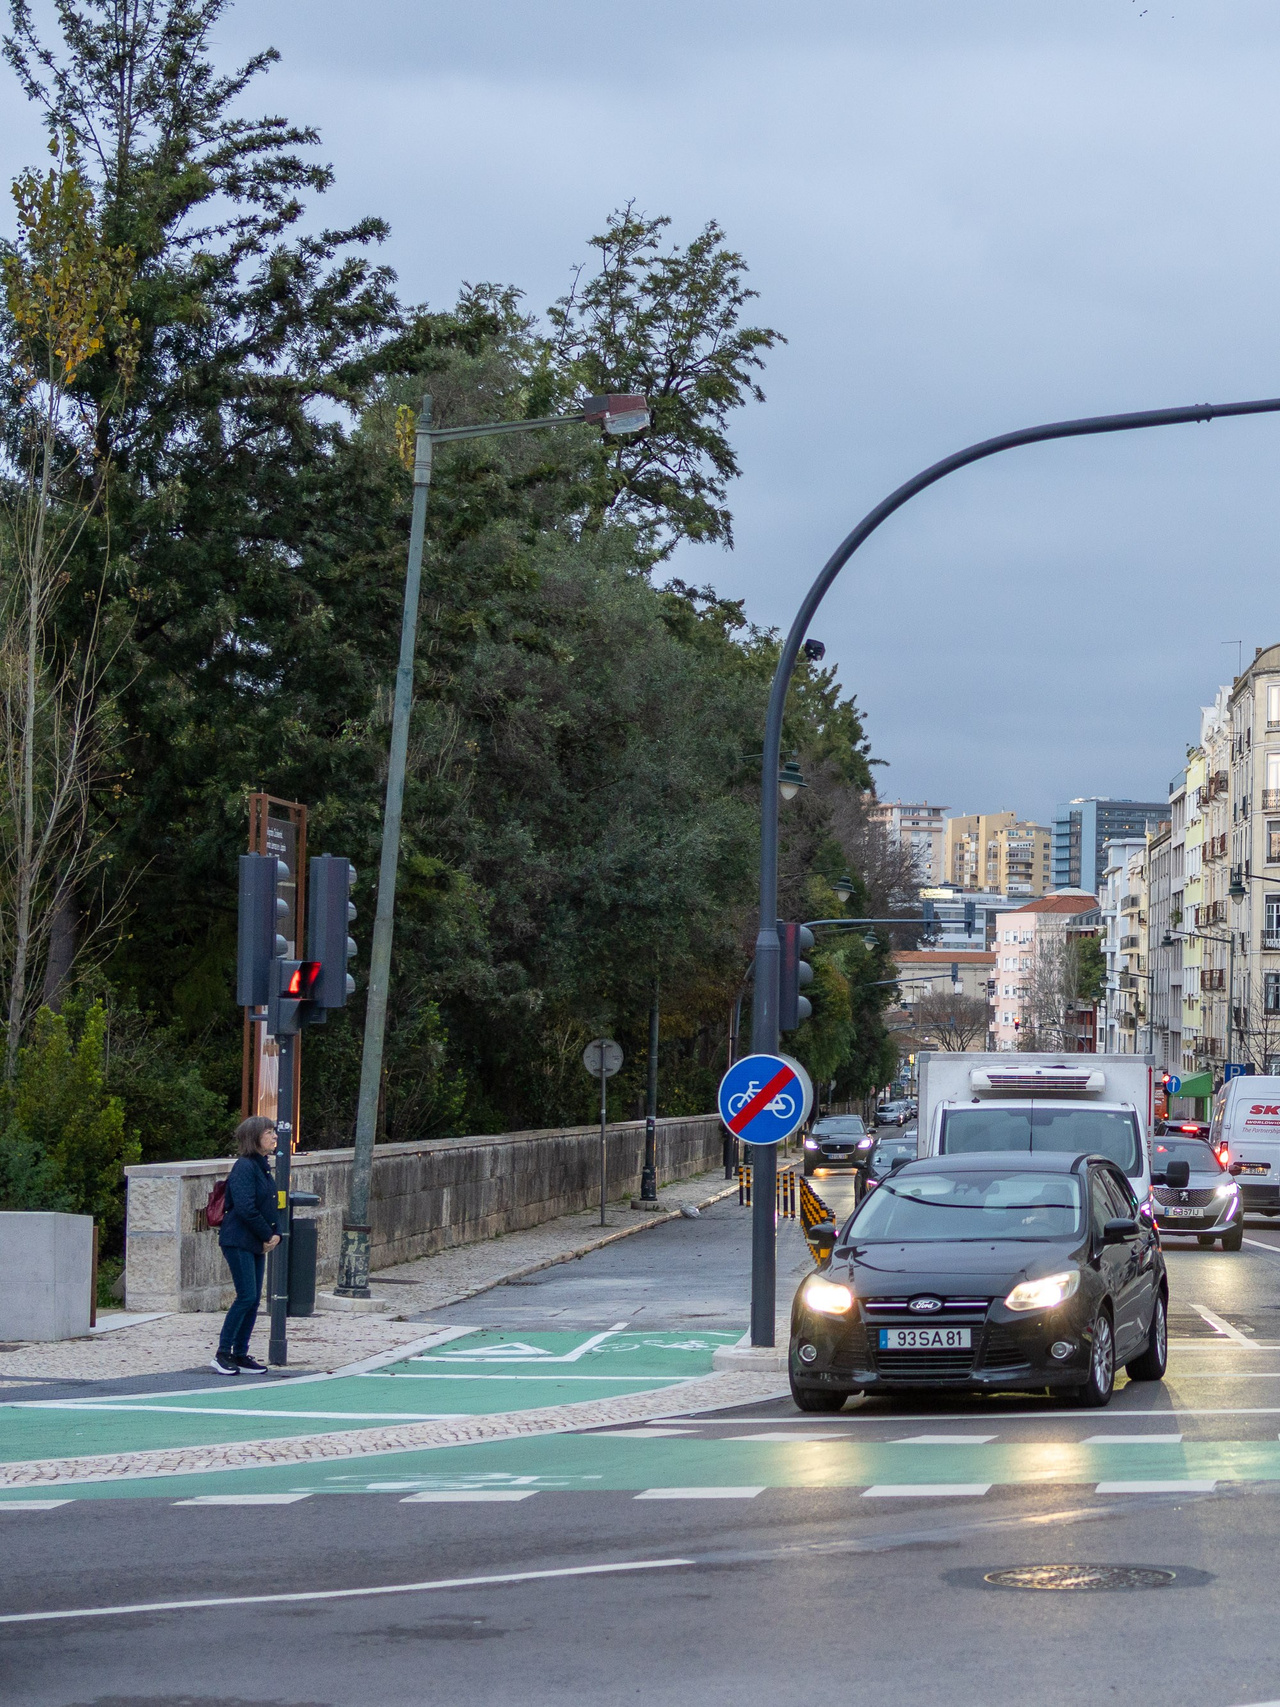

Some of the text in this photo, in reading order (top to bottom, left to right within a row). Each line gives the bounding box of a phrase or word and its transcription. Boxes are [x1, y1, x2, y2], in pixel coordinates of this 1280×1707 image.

[1230, 1066, 1241, 1079] P
[916, 1300, 934, 1309] Ford
[898, 1330, 962, 1346] 93SA81
